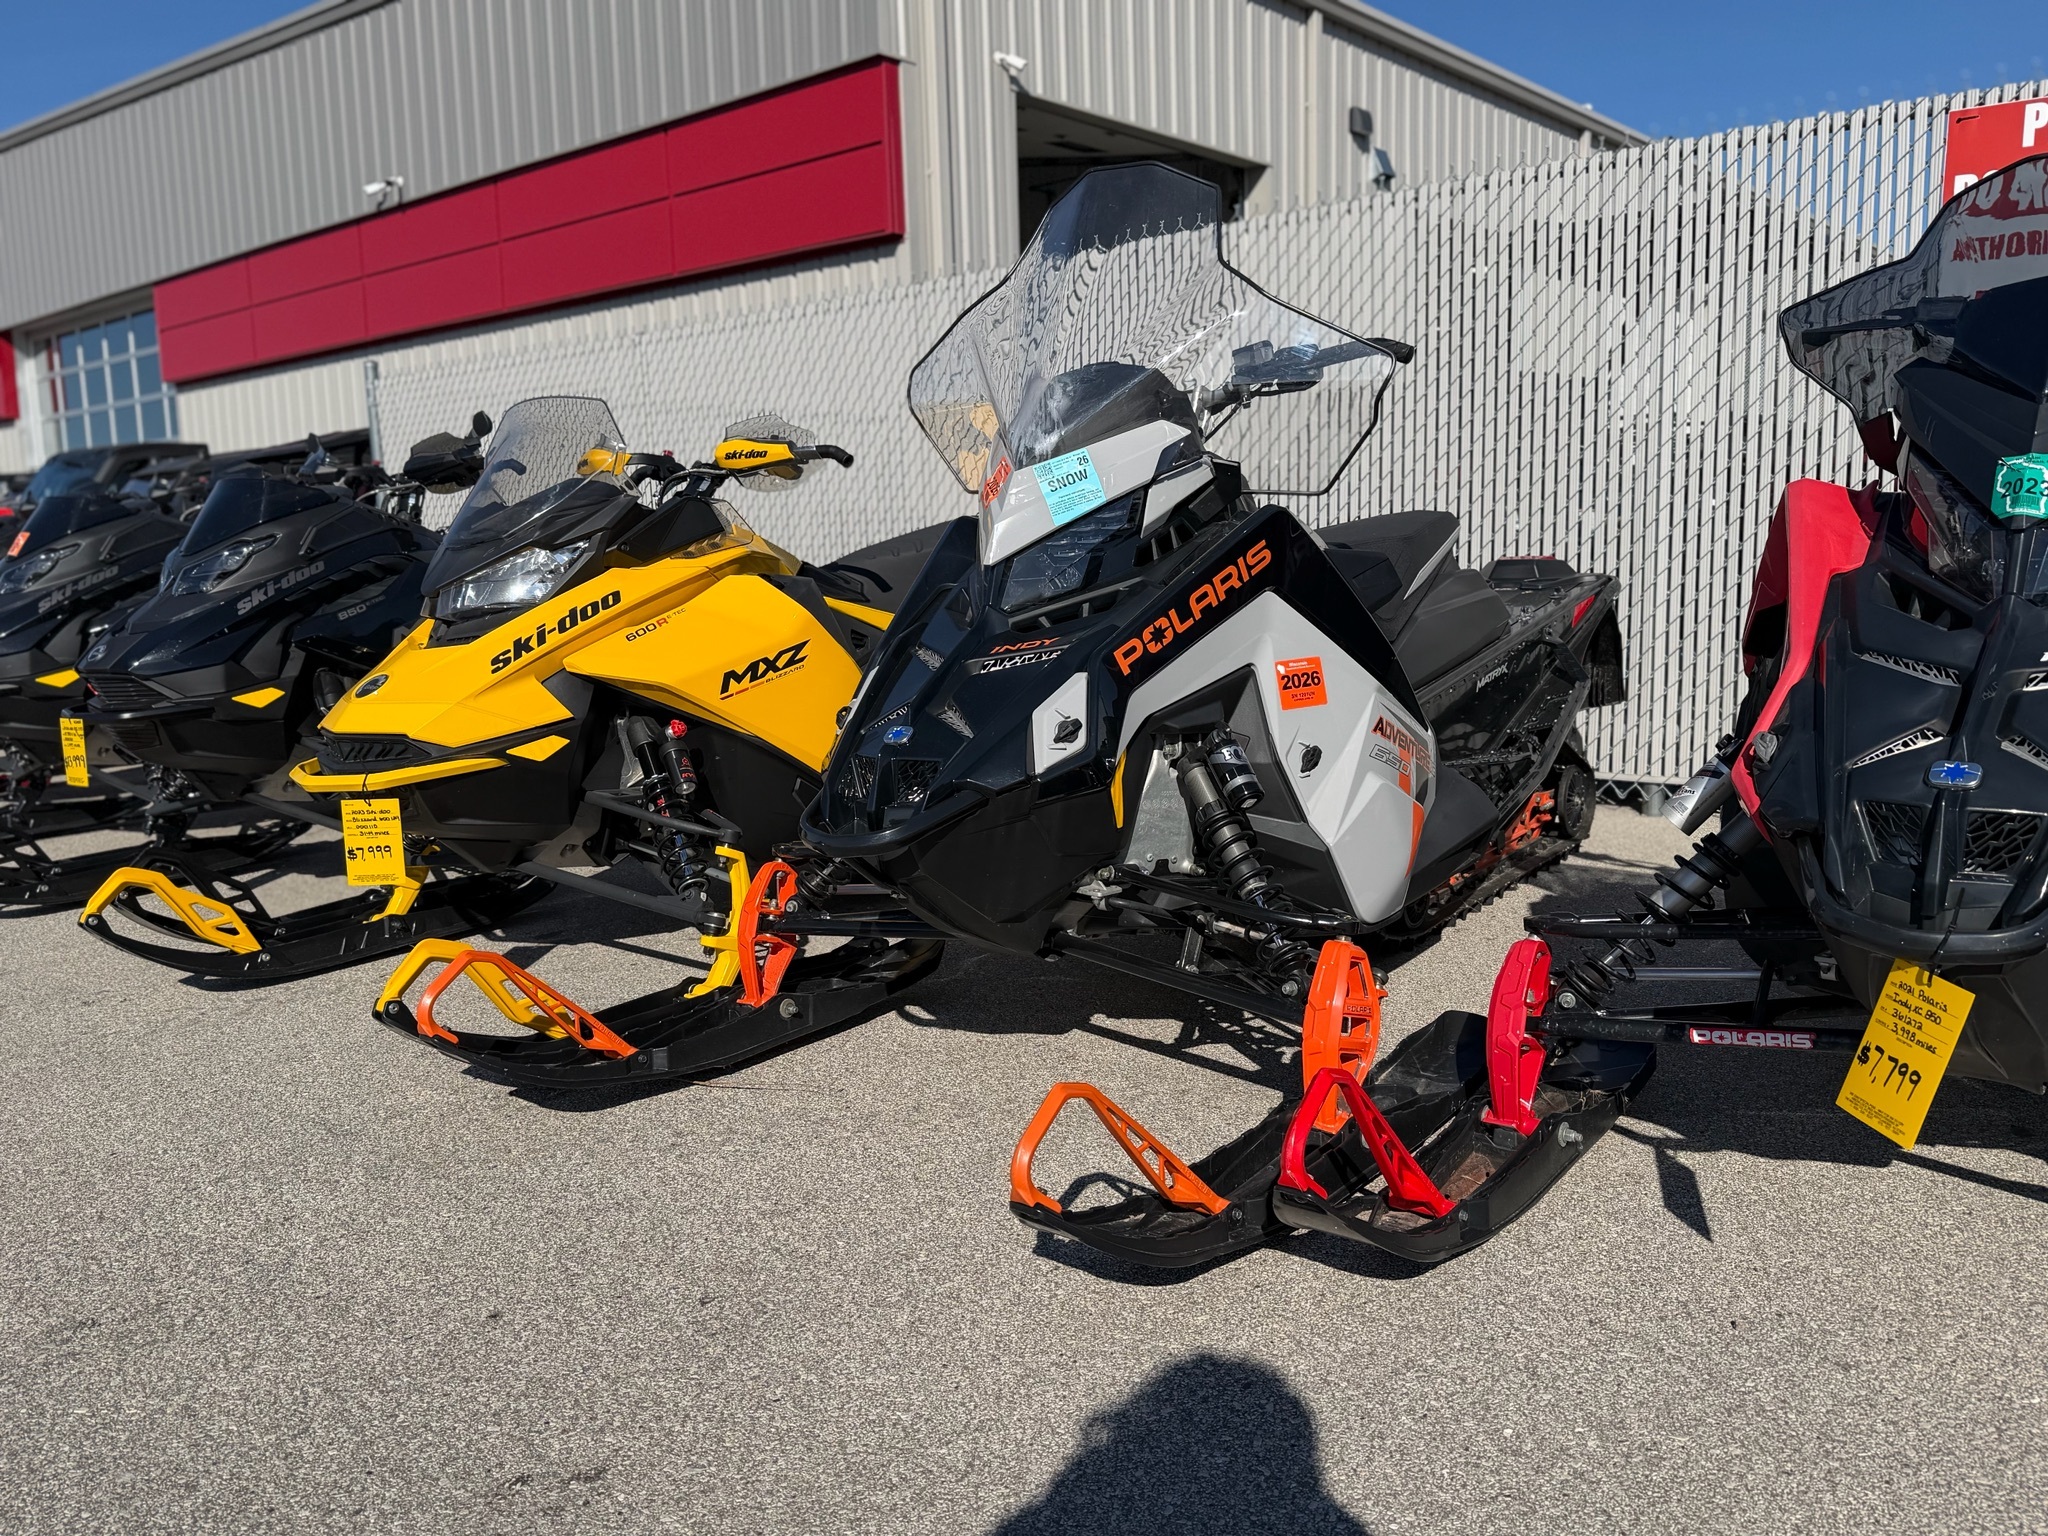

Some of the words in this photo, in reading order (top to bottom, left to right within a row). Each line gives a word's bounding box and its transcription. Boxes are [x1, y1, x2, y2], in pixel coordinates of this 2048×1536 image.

[724, 449, 768, 460] ski-doo
[1076, 455, 1090, 466] 26
[1047, 468, 1089, 493] SNOW
[2001, 477, 2048, 499] 2023
[38, 565, 119, 614] ski-doo
[237, 560, 325, 616] ski-doo
[337, 603, 367, 621] 850
[1113, 539, 1273, 677] POLARIS
[490, 589, 622, 675] ski-doo
[625, 617, 669, 642] 600R
[989, 637, 1061, 655] INDY
[720, 638, 811, 696] MXZ
[765, 664, 805, 683] BLIZZARD
[1281, 670, 1321, 690] 2026
[1476, 662, 1510, 693] MATRYX
[1221, 746, 1248, 762] FO
[1369, 743, 1412, 777] 650
[1371, 715, 1435, 778] ADVENTURE
[347, 845, 393, 861] $7,999
[1892, 992, 1912, 1013] Indy
[1924, 1010, 1942, 1025] 850
[1898, 981, 1915, 996] 2021
[1919, 989, 1948, 1013] Polaris
[1693, 1029, 1814, 1049] POLARIS
[1891, 1022, 1917, 1043] 3,998
[1915, 1039, 1938, 1055] miles
[1856, 1040, 1922, 1101] $7,799
